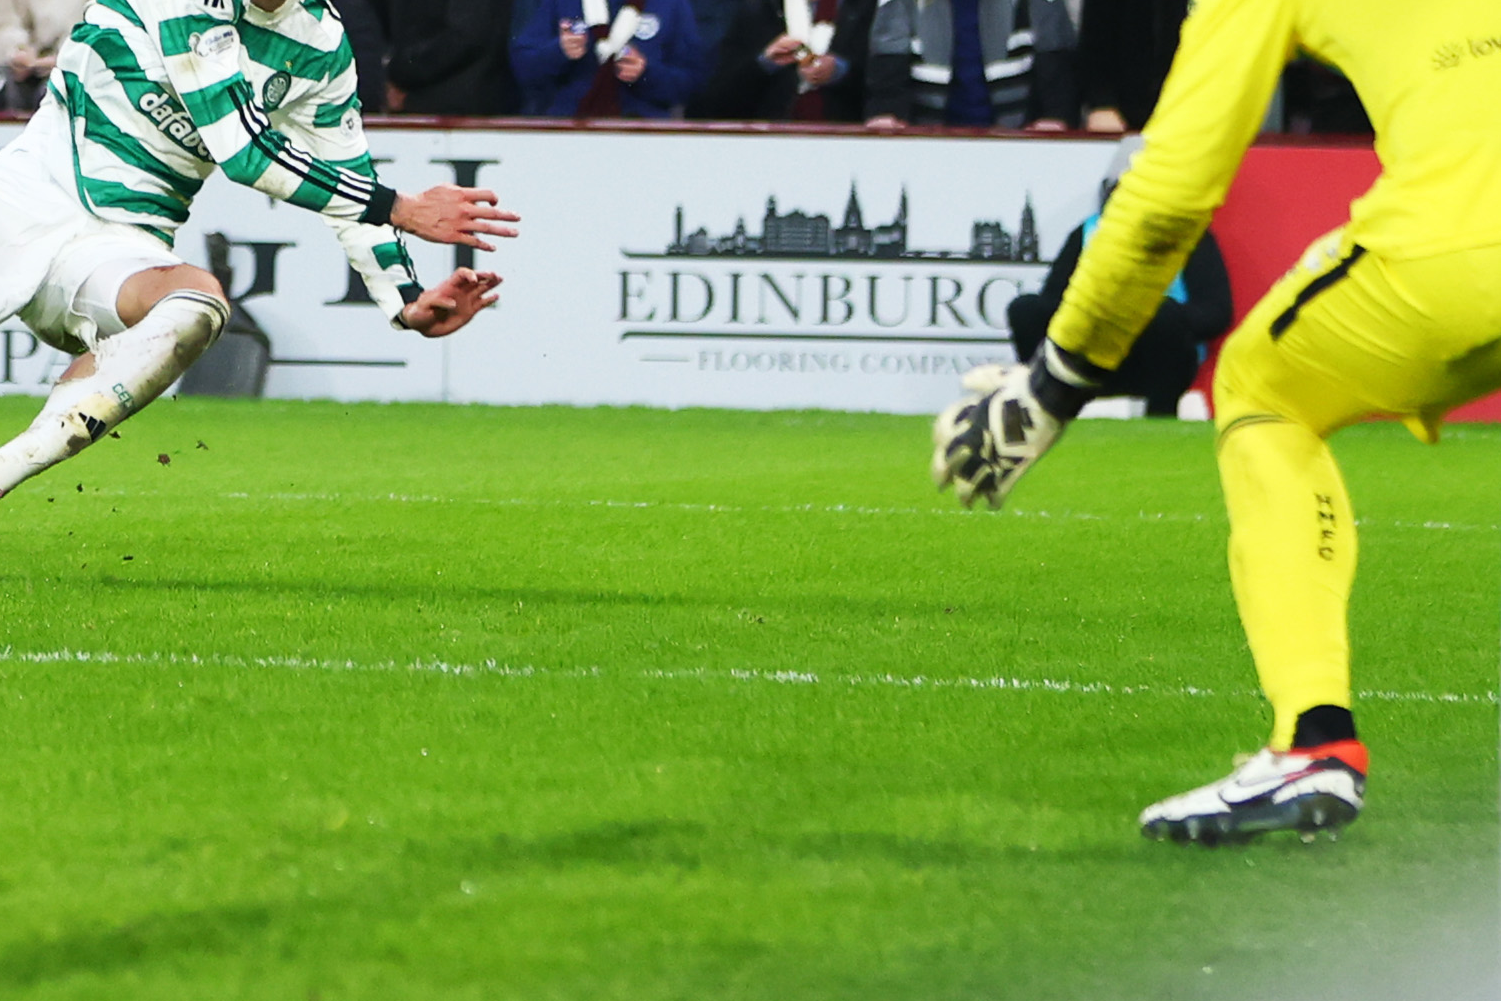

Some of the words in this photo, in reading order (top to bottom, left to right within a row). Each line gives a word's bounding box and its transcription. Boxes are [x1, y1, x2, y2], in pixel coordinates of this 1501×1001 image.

[139, 92, 215, 161] dafabe
[616, 269, 1045, 329] EDINBURG
[697, 349, 851, 375] FLOORING
